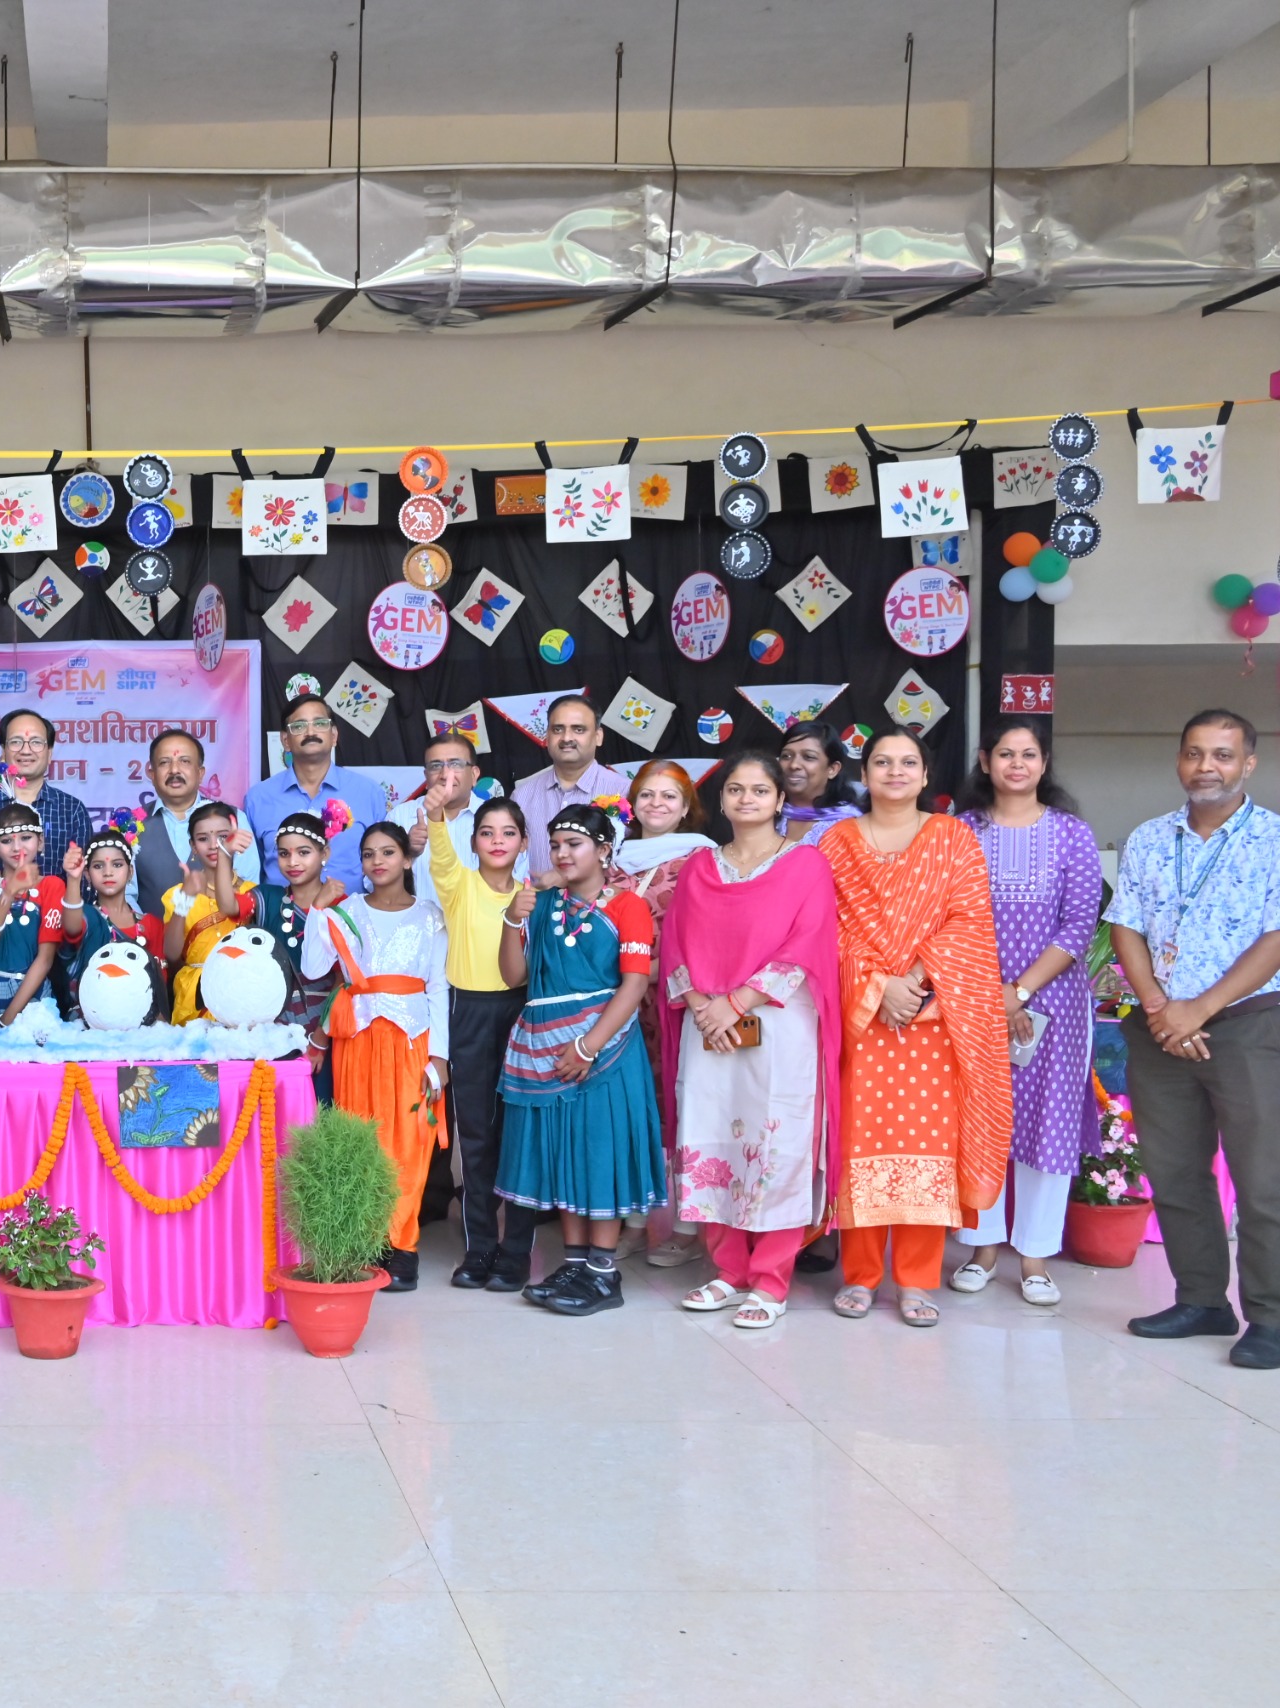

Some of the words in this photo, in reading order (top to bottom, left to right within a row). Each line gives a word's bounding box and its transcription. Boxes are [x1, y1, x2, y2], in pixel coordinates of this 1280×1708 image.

[381, 605, 442, 635] GEM
[679, 597, 725, 626] GEM
[899, 592, 964, 620] GEM
[197, 608, 223, 638] GEM
[43, 668, 106, 692] GEM
[116, 667, 157, 681] सीपत
[116, 680, 156, 690] SIPAT
